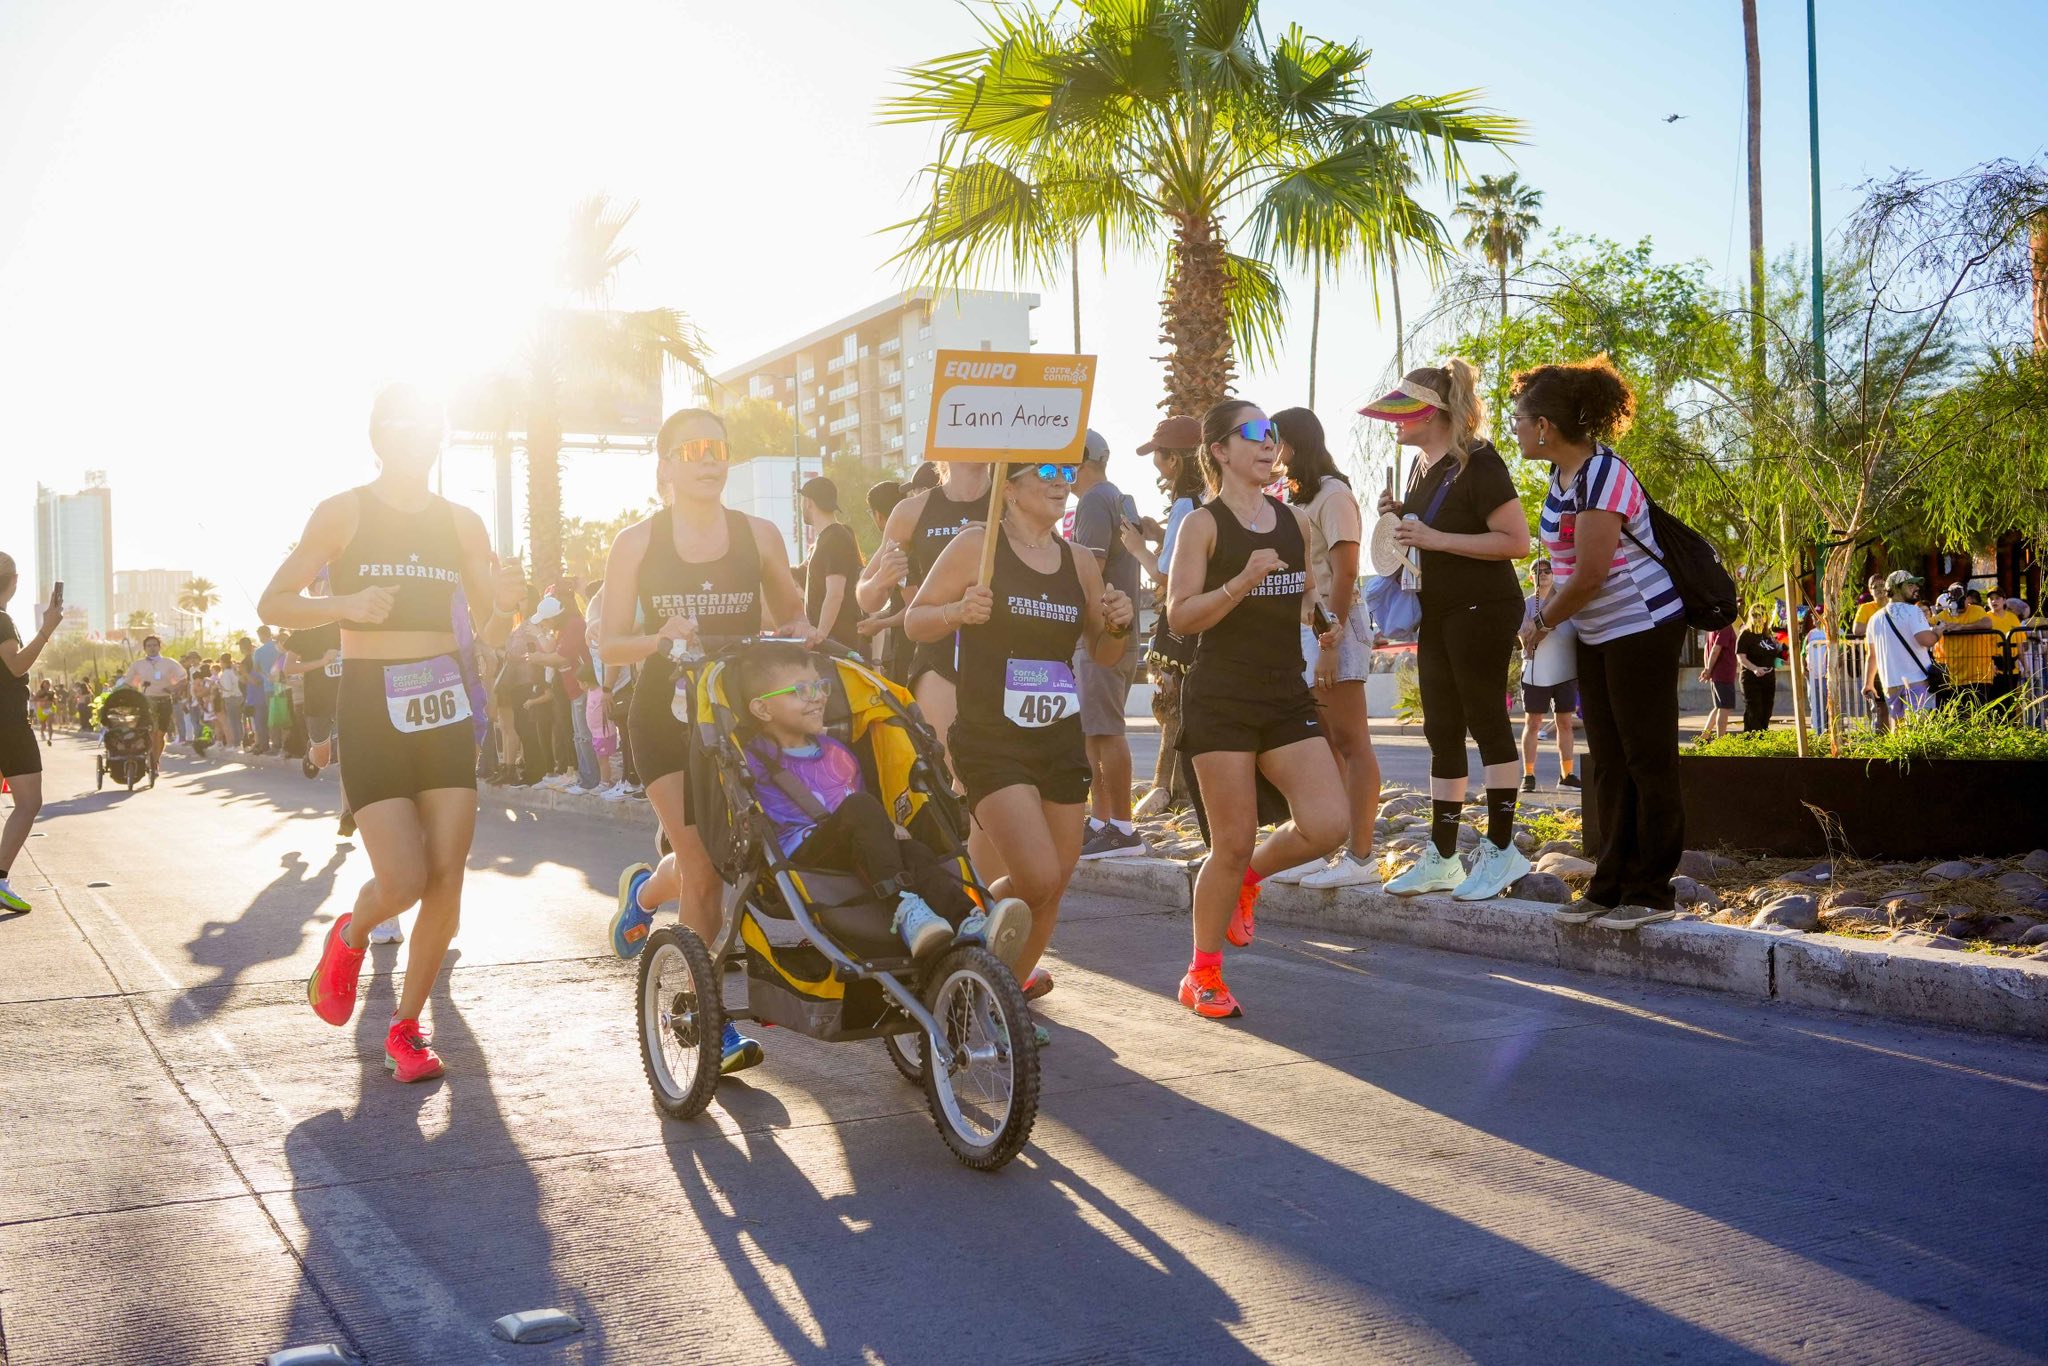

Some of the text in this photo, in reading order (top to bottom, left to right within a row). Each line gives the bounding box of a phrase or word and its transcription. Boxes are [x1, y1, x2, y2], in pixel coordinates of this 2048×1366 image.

[944, 361, 1017, 380] EQUIPO
[1044, 366, 1071, 374] corre
[948, 403, 1069, 427] Iann Andres
[359, 564, 460, 584] PEREGRINOS
[652, 592, 754, 608] PEREGRINOS
[1008, 596, 1078, 616] PEREGRINOS
[658, 604, 749, 617] CORREDORES
[1011, 606, 1076, 623] CORREDORES
[406, 690, 456, 726] 496
[1019, 695, 1067, 723] 462
